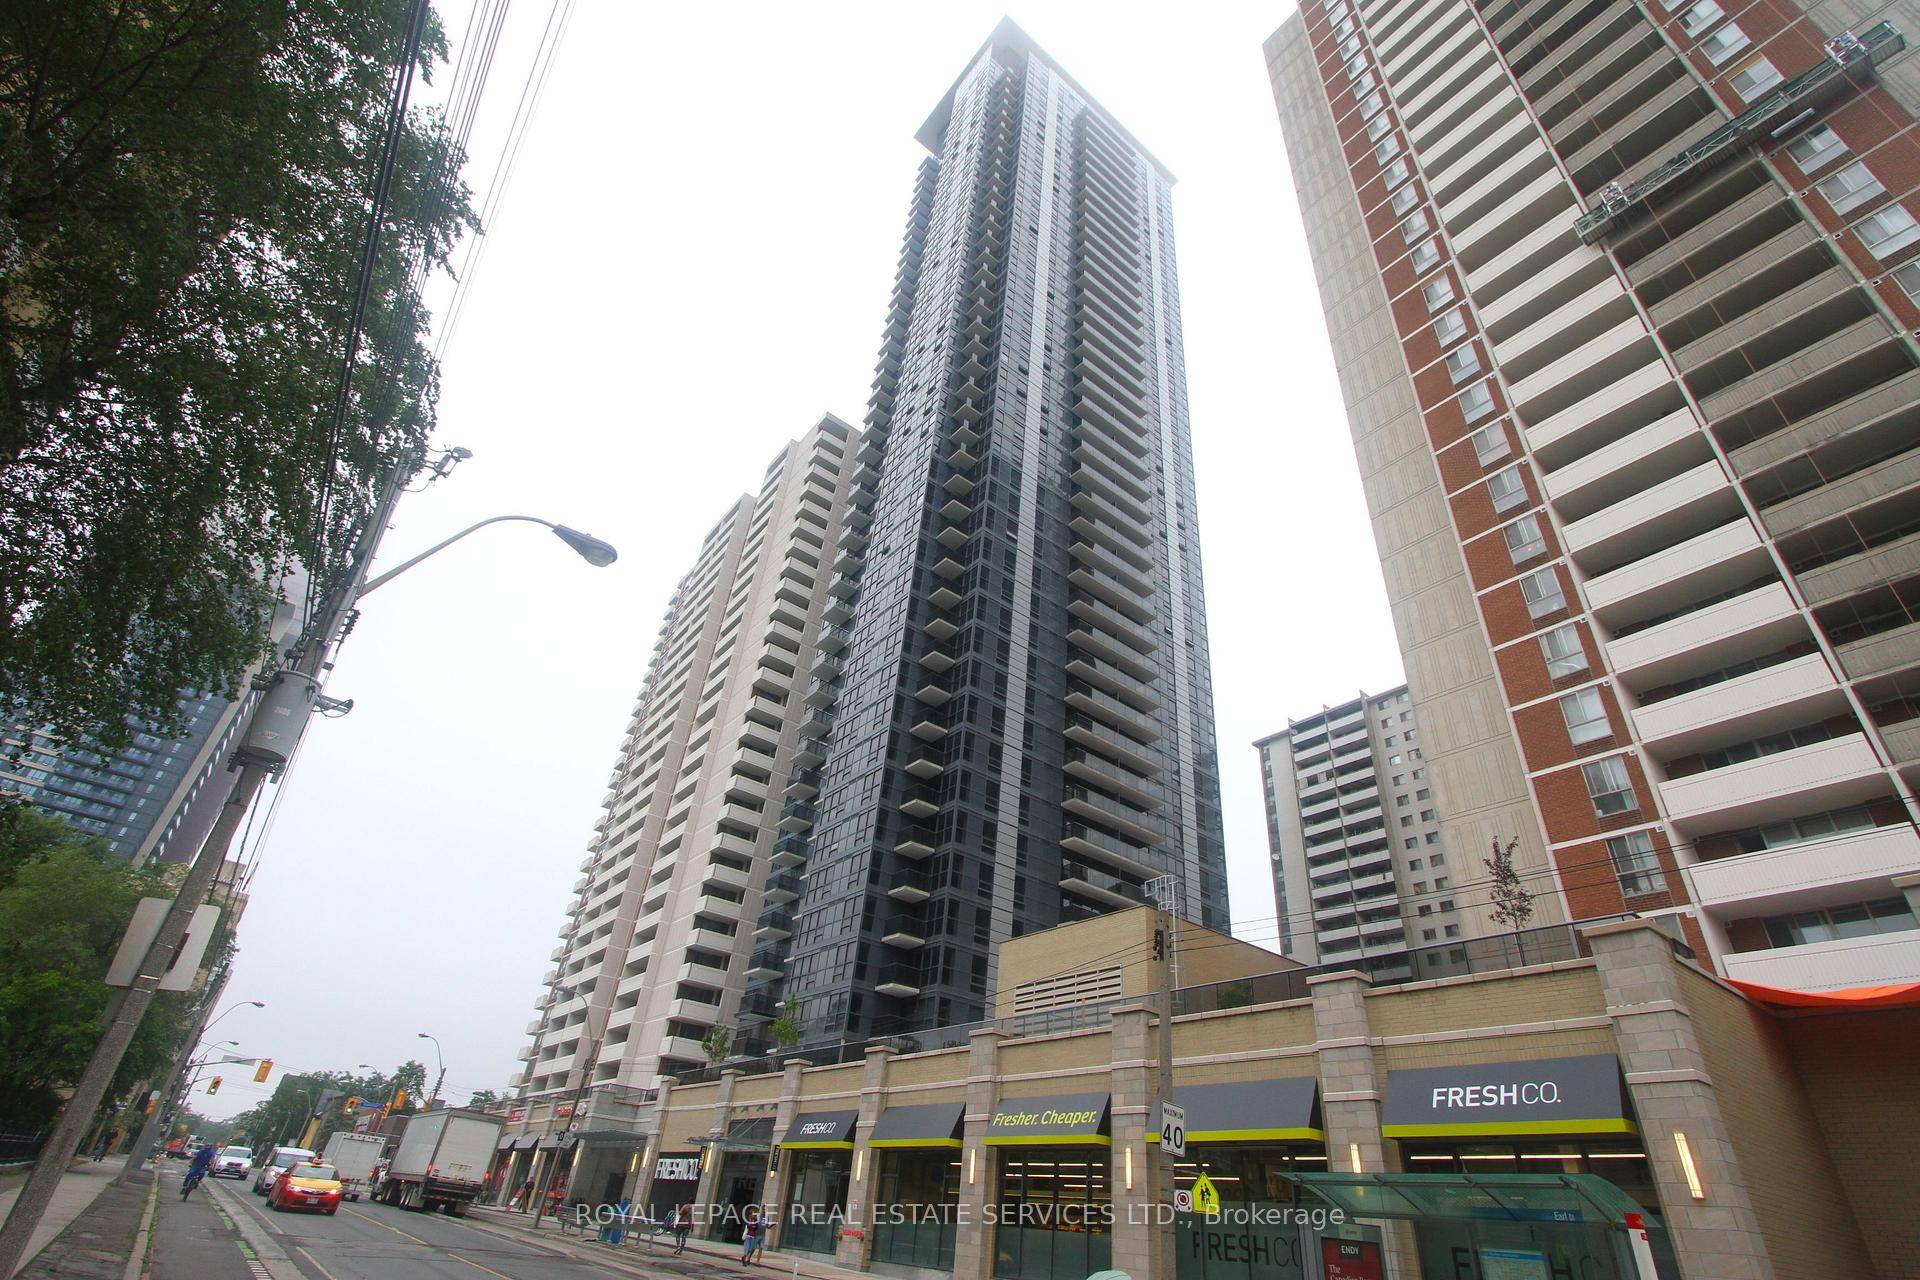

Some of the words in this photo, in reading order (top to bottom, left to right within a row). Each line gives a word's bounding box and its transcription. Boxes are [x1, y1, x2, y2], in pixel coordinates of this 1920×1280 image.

[992, 1111, 1039, 1127] Fresher.
[1040, 1109, 1097, 1127] Cheaper.
[1162, 1123, 1184, 1149] 40
[1341, 1245, 1359, 1255] ENDY
[1328, 1264, 1341, 1274] The
